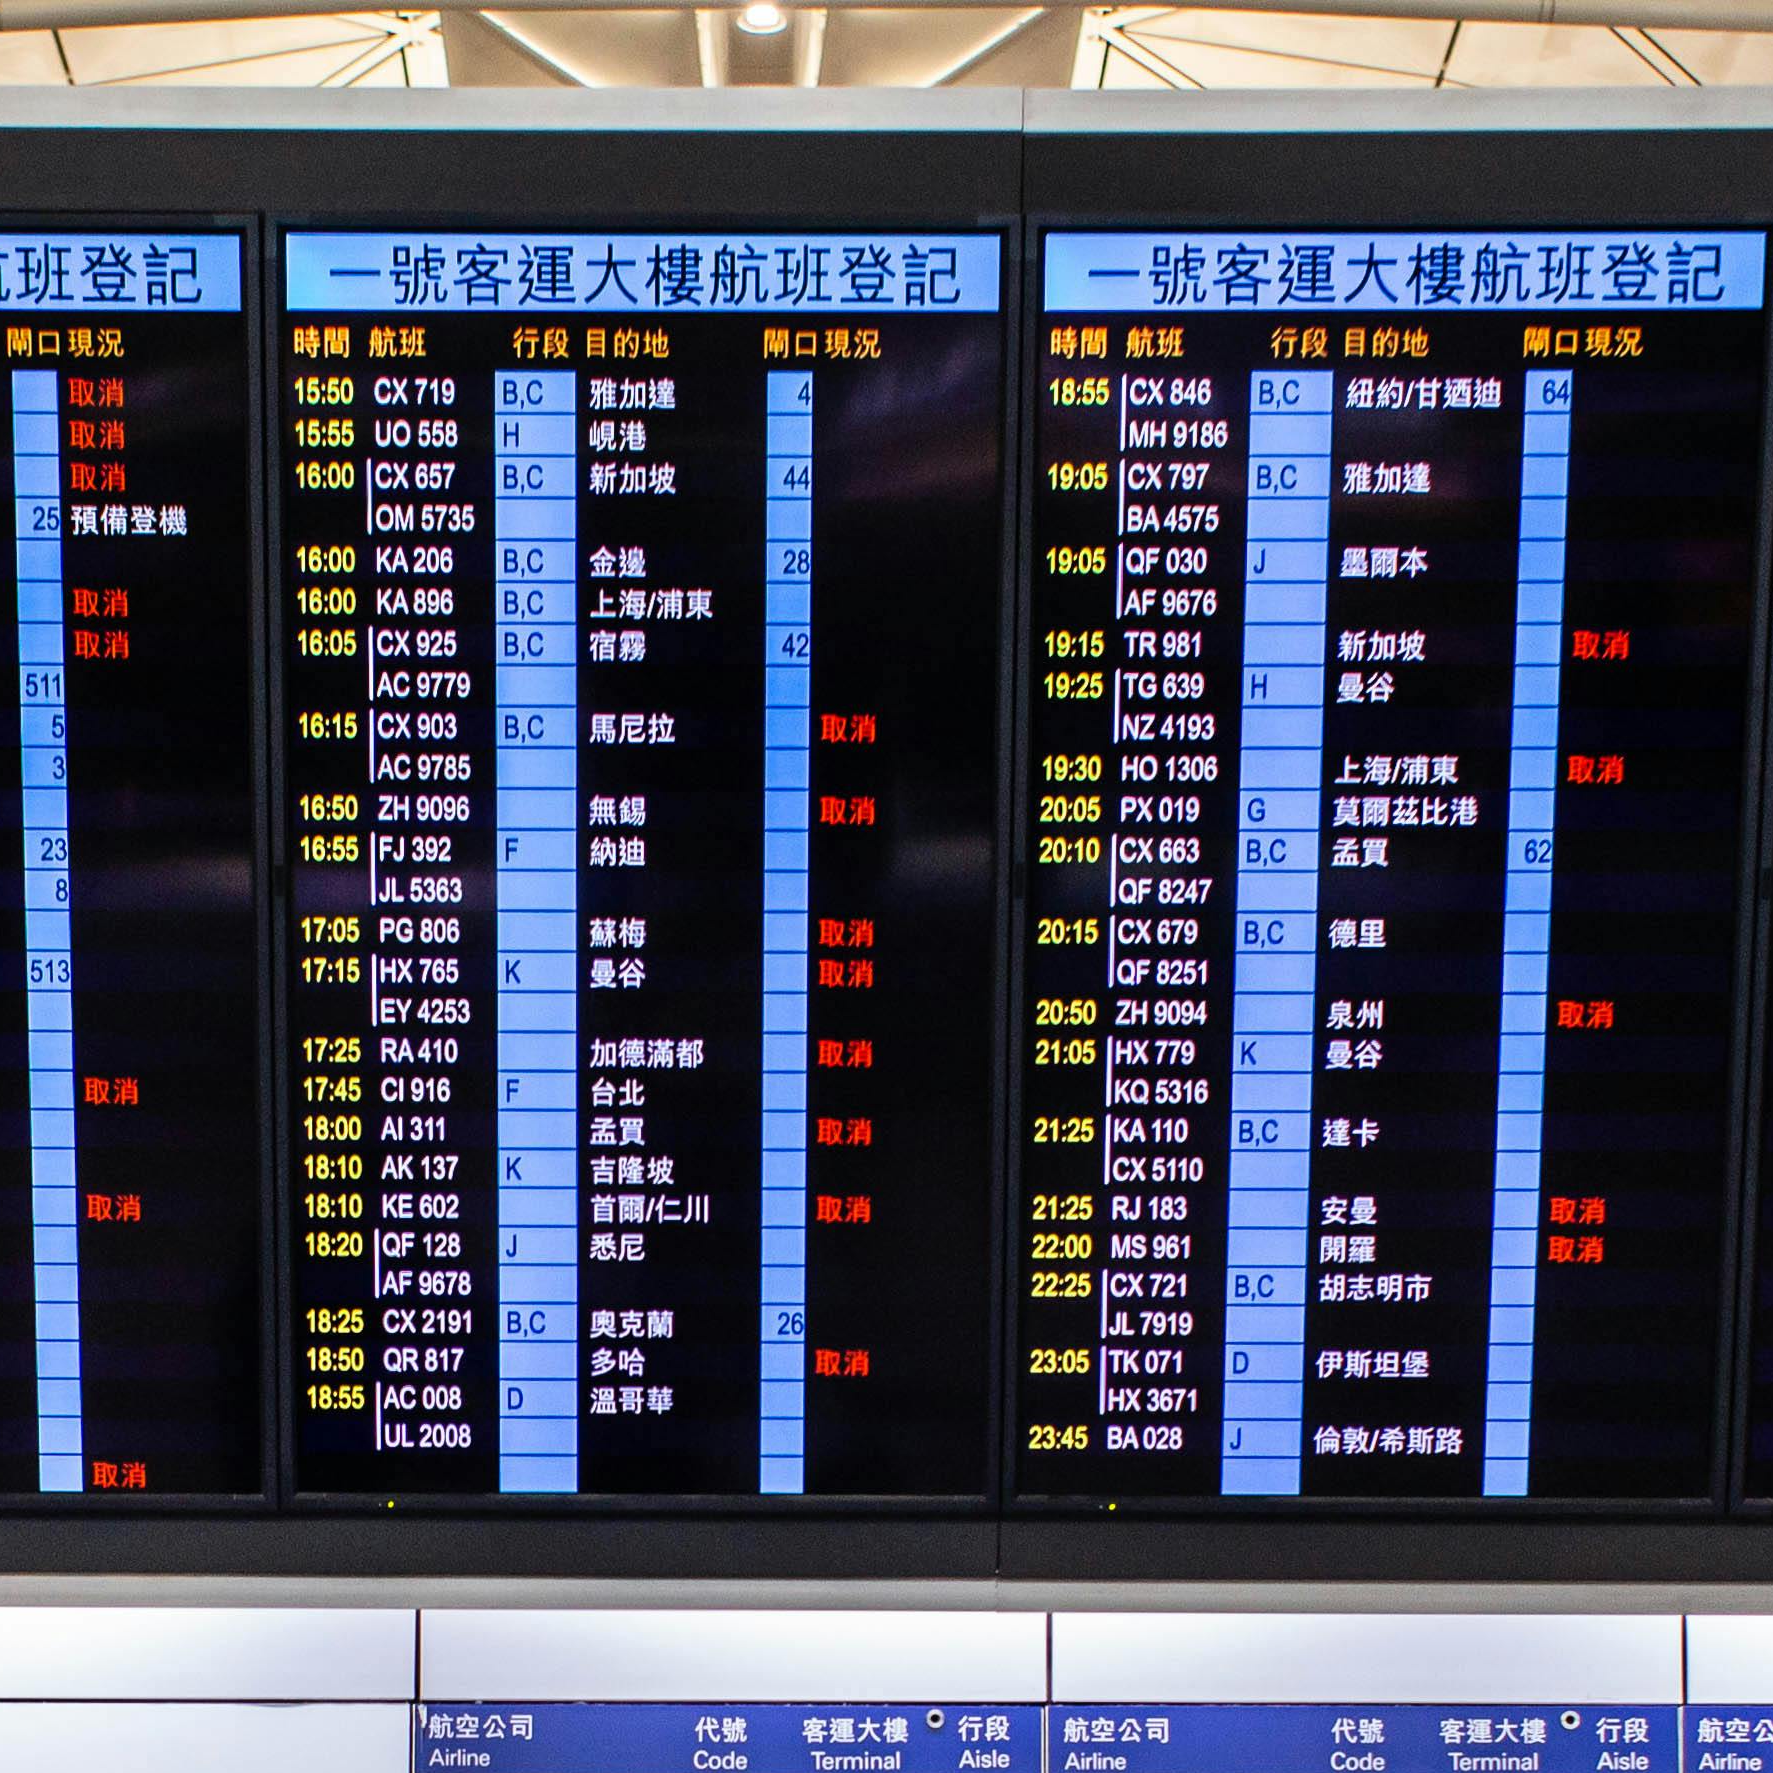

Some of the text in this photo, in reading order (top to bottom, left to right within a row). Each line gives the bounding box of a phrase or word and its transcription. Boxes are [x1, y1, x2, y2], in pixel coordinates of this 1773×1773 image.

[330, 243, 960, 307] 一號客運大樓航班登記
[1088, 240, 1726, 305] 一號客運大樓航班登記
[7, 327, 59, 357] 閘口
[68, 328, 124, 357] 現況
[68, 378, 123, 407] 取消
[295, 376, 810, 410] 15:50 CX 719 B,C 雅加達 4
[1048, 462, 1431, 494] 19:05 CX 797 B,C 雅加達
[34, 507, 59, 530] 25
[71, 504, 187, 536] 預備登機
[26, 673, 60, 698] 511
[1043, 755, 1623, 785] 19:30 HO 1306 上海/浦東 取消
[301, 916, 873, 948] 17:05 PG 806 蘇梅 取消
[1036, 999, 1613, 1030] 20:50 ZH 9094 泉州 取消
[307, 1385, 673, 1414] 18:55 AC 008 D 溫哥華
[1029, 1425, 1463, 1454] 23:45 BA 028 J 倫敦/希斯路
[93, 1462, 146, 1488] 取消
[429, 1714, 1010, 1743] 航空公司 代號 客運大樓 行段
[428, 1748, 1011, 1771] Airline Code Terminal Aisle
